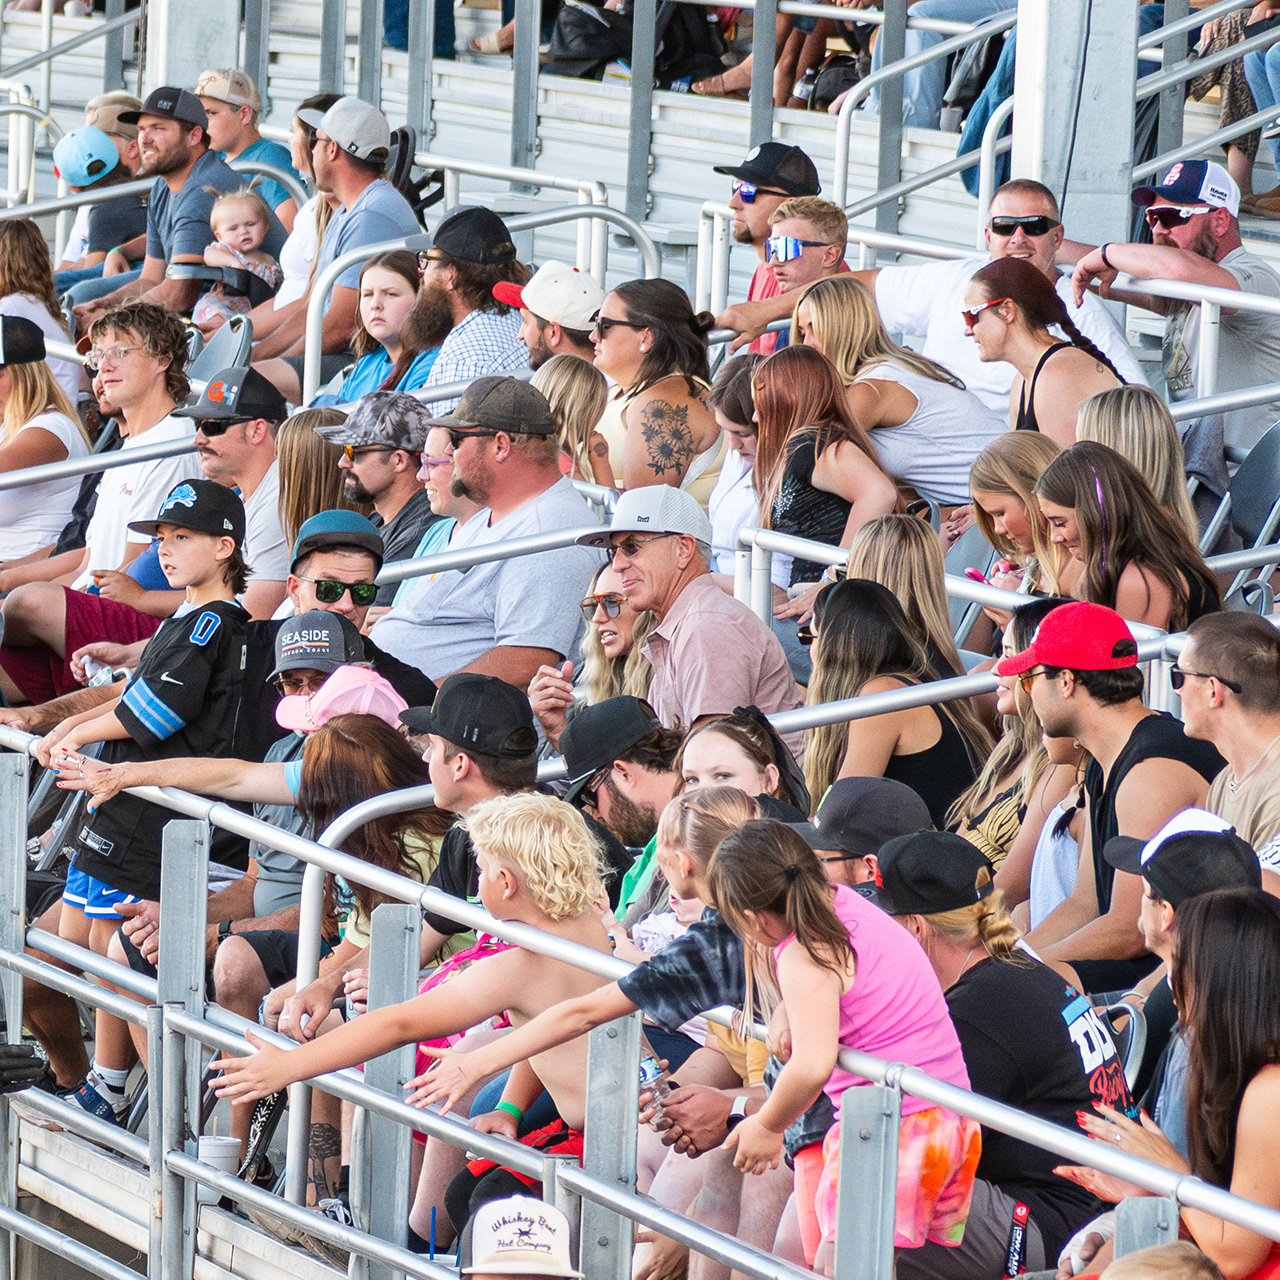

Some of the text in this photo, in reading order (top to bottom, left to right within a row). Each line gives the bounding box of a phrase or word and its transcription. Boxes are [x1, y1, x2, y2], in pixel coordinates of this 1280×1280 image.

[157, 100, 174, 110] CAT
[281, 630, 330, 646] SEASIDE
[491, 1212, 535, 1232] Whiskey
[516, 1239, 551, 1252] Company
